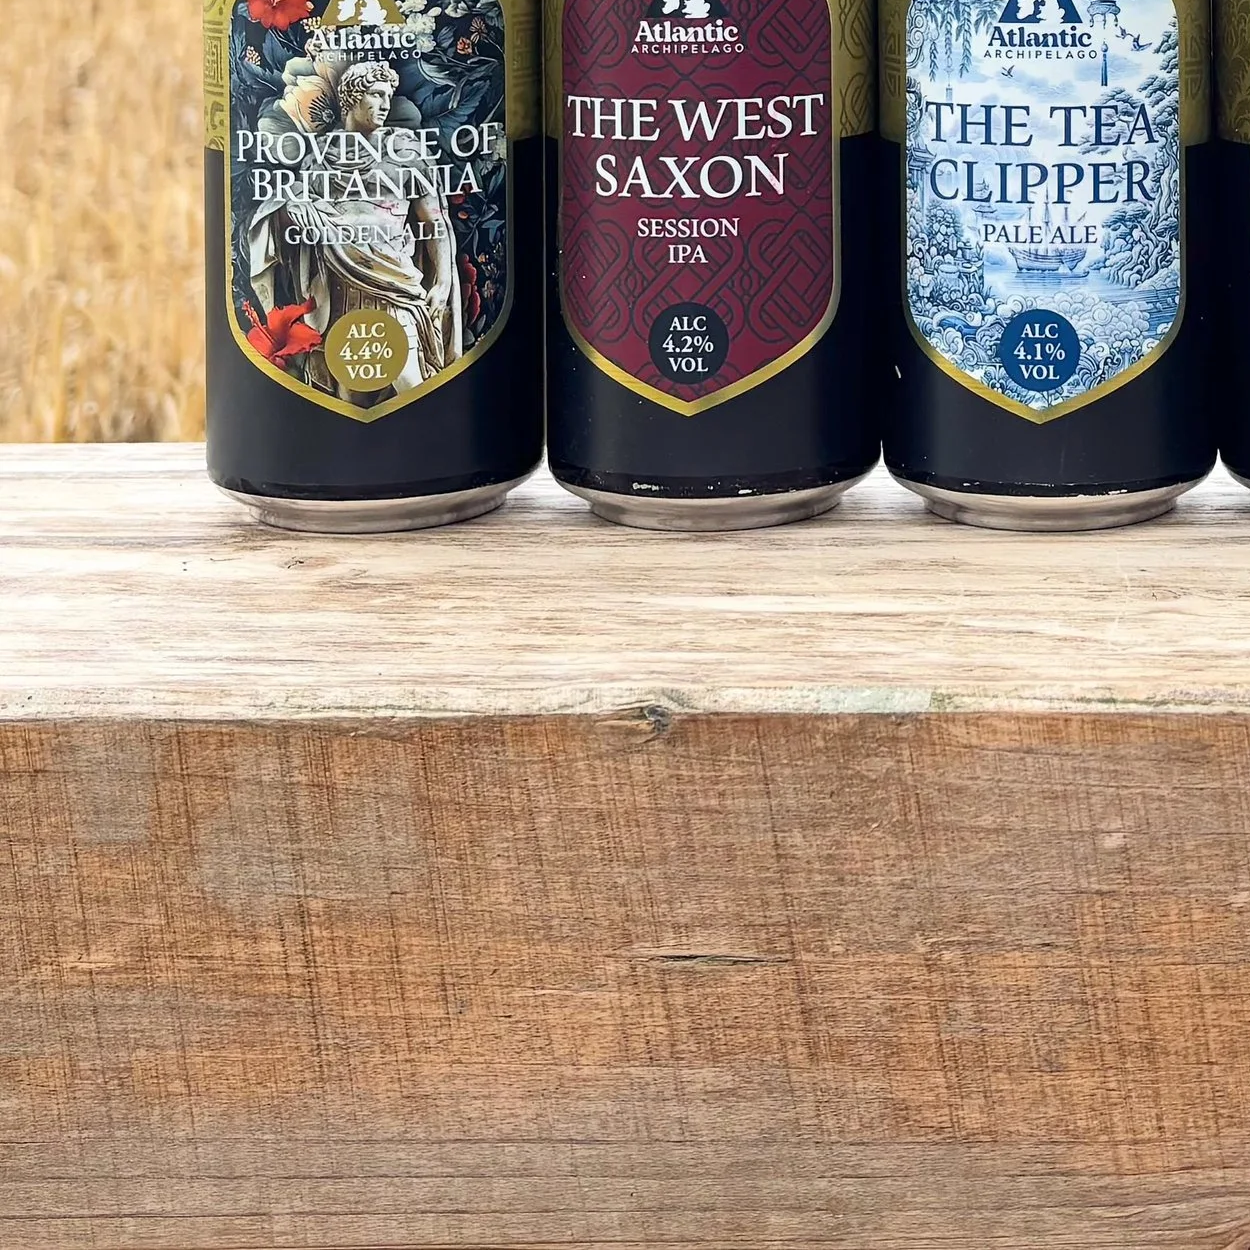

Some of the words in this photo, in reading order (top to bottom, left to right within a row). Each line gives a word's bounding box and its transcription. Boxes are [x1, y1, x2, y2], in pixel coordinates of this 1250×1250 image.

[308, 28, 416, 50] Atlantic
[634, 20, 739, 43] Atlantic
[988, 26, 1092, 48] Atlantic
[305, 50, 422, 62] ARCHIPELAGO
[630, 43, 744, 54] ARCHIPELAGO
[984, 49, 1098, 59] ARCHIPELAGO
[567, 95, 661, 140] THE
[668, 94, 824, 140] WEST
[925, 101, 1033, 147] THE
[1050, 103, 1159, 147] TEA
[236, 128, 440, 165] PROVINCE
[450, 122, 500, 157] OF
[252, 163, 483, 202] BRITANNIA
[595, 153, 789, 199] SAXON
[930, 159, 1156, 205] CLIPPER
[284, 225, 391, 245] GOLDEN
[402, 221, 446, 242] ALE
[637, 217, 740, 238] SESSION
[982, 224, 1042, 245] PALE
[1050, 224, 1099, 244] ALE
[668, 244, 708, 264] IPA
[345, 323, 385, 339] ALC
[669, 316, 707, 331] ALC
[1020, 323, 1059, 339] ALC
[339, 342, 393, 361] 4.4%
[662, 335, 714, 353] 4.2%
[1013, 343, 1066, 361] 4.1%
[345, 363, 387, 378] VOL
[668, 357, 708, 372] VOL
[1019, 364, 1060, 380] VOL
